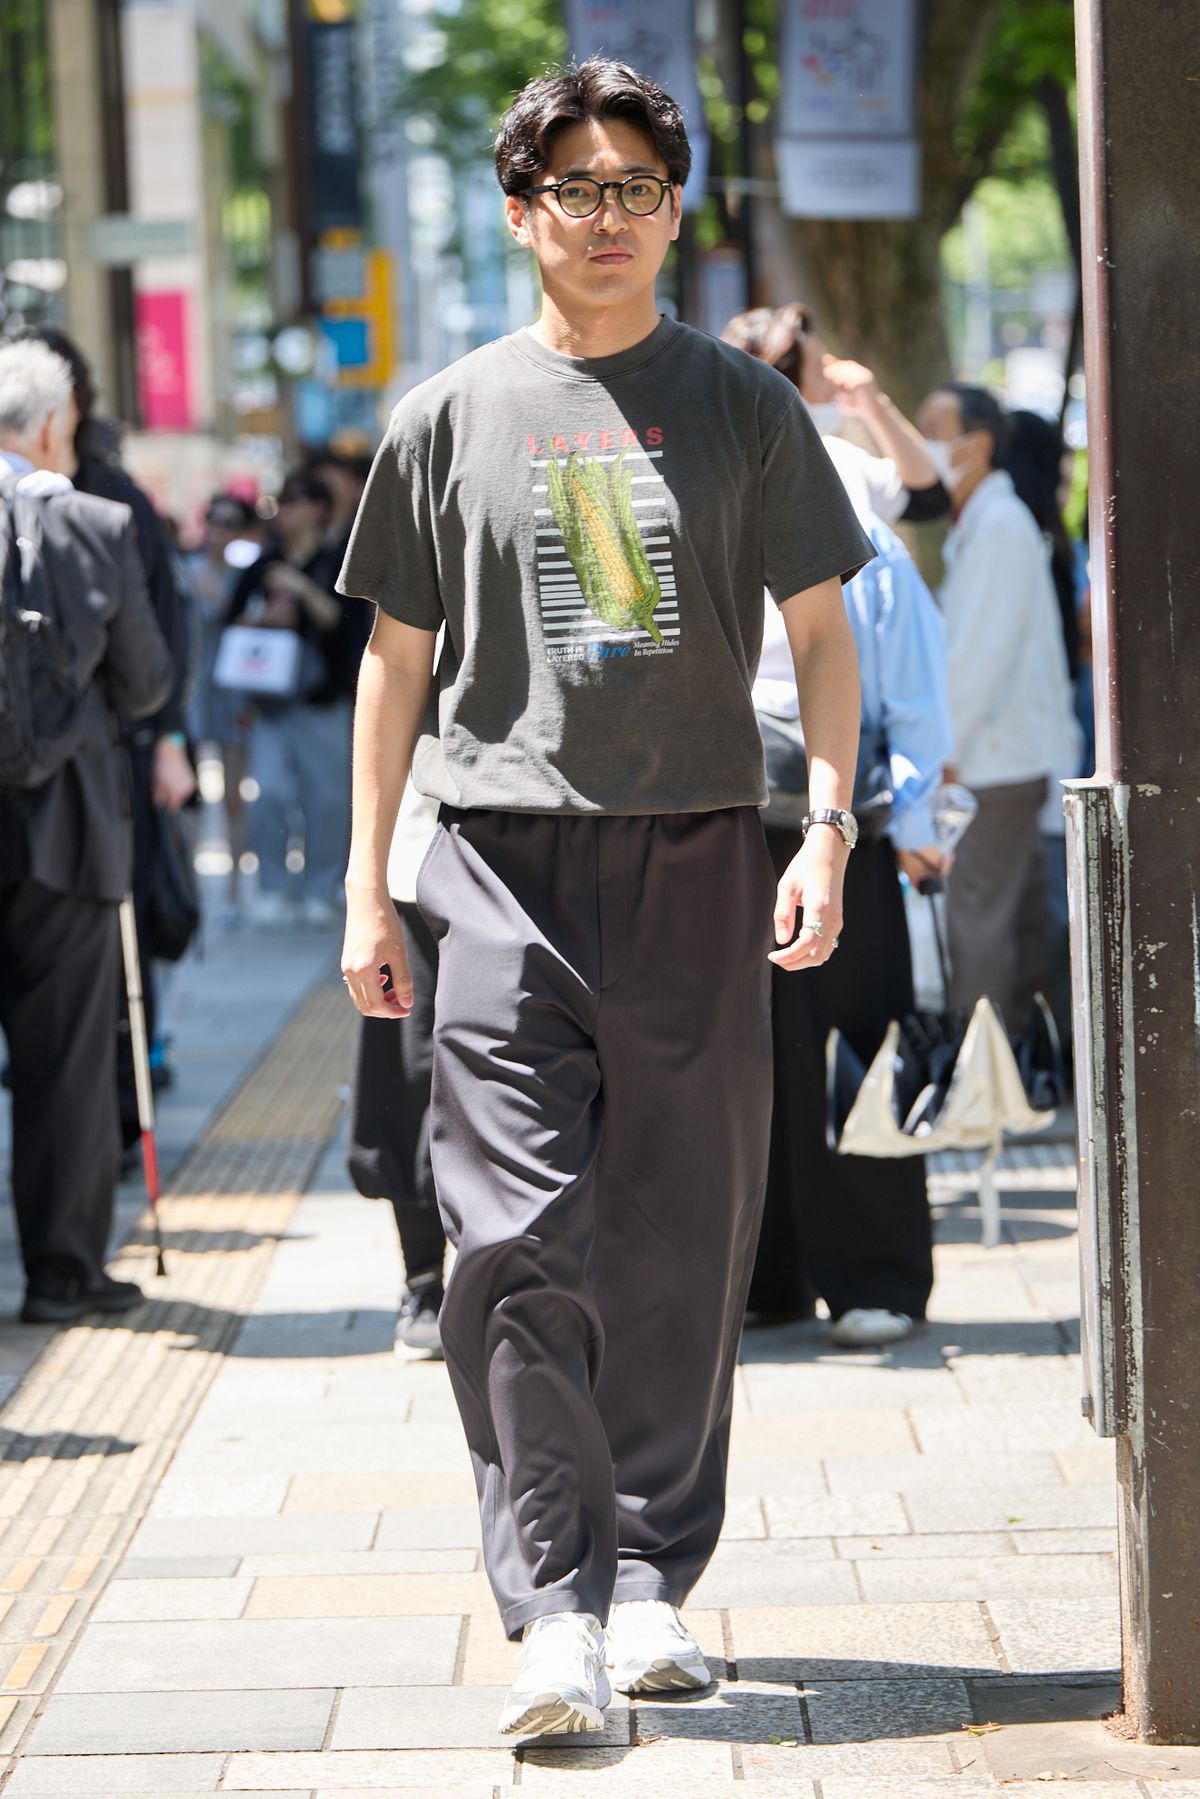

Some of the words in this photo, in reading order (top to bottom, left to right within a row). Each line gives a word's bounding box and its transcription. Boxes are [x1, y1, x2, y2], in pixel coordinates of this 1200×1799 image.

[527, 427, 664, 453] LAYERS
[633, 640, 661, 649] Meaning
[661, 638, 680, 647] Hides
[546, 646, 575, 655] TRUTH
[575, 645, 585, 653] IS
[643, 647, 674, 657] Repetition
[546, 653, 585, 663] LAYERED
